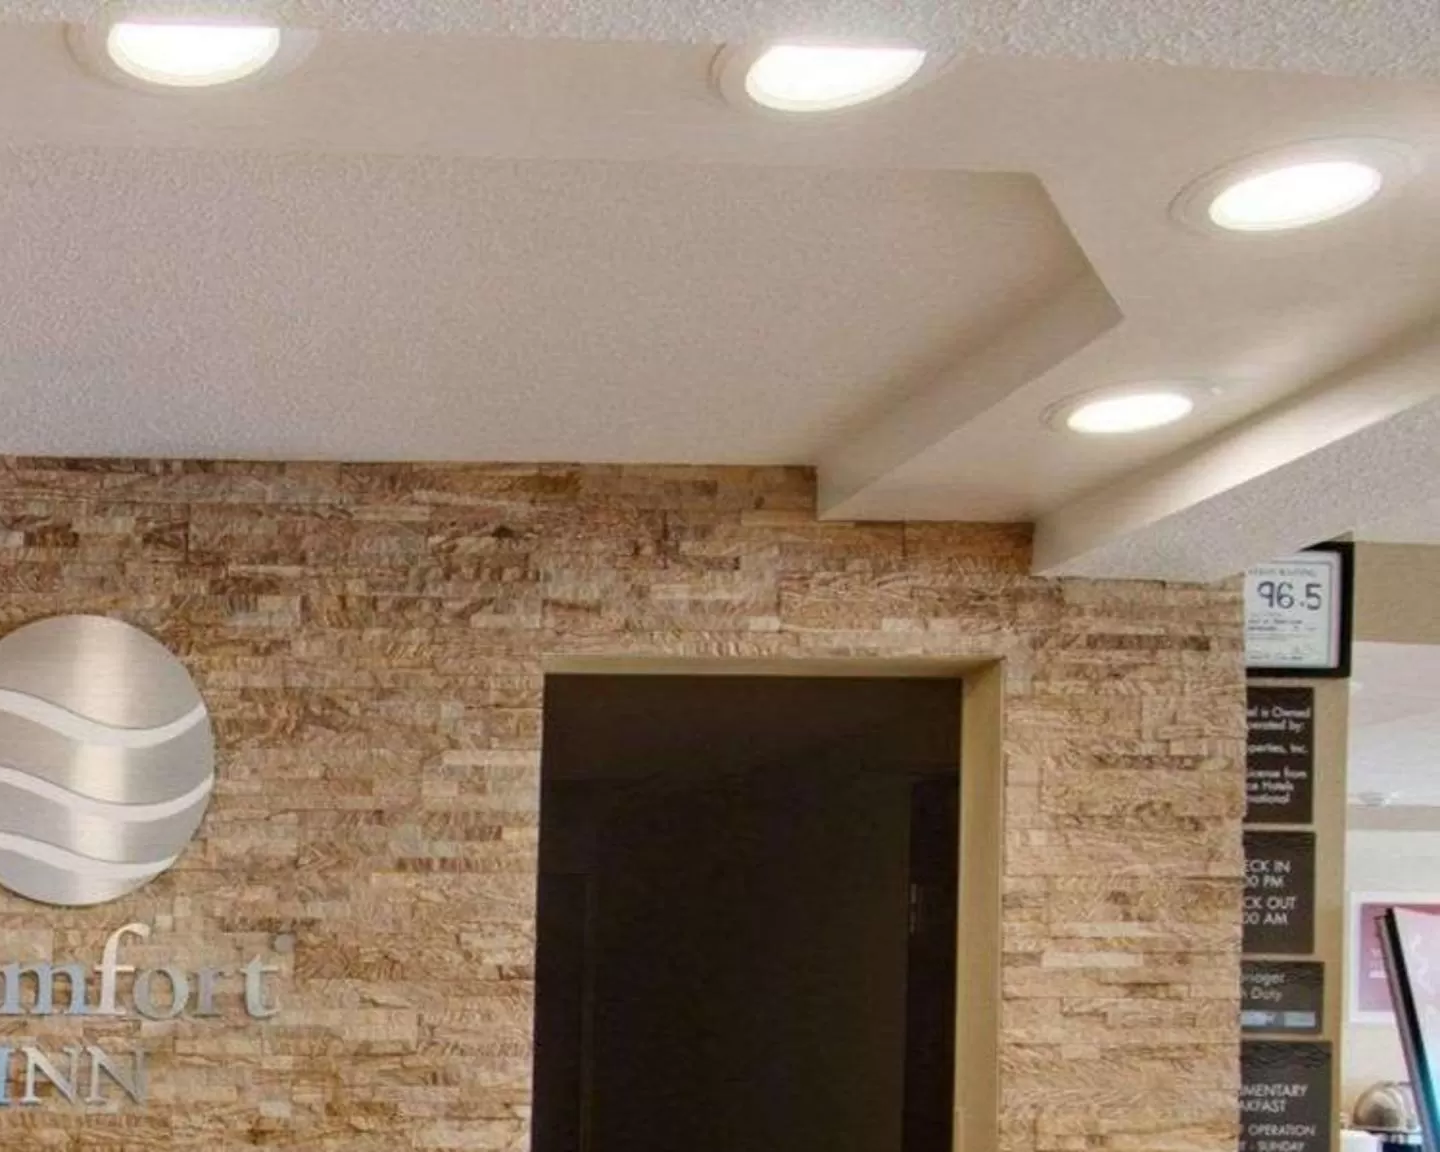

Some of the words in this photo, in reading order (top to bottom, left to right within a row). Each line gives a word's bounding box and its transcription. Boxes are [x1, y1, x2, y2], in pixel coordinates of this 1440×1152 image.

[1257, 581, 1323, 611] 96.5
[1274, 860, 1291, 873] IN
[1263, 875, 1284, 888] PM
[1266, 896, 1298, 910] OUT
[1263, 911, 1288, 925] AM
[1248, 1124, 1316, 1137] OPERATION
